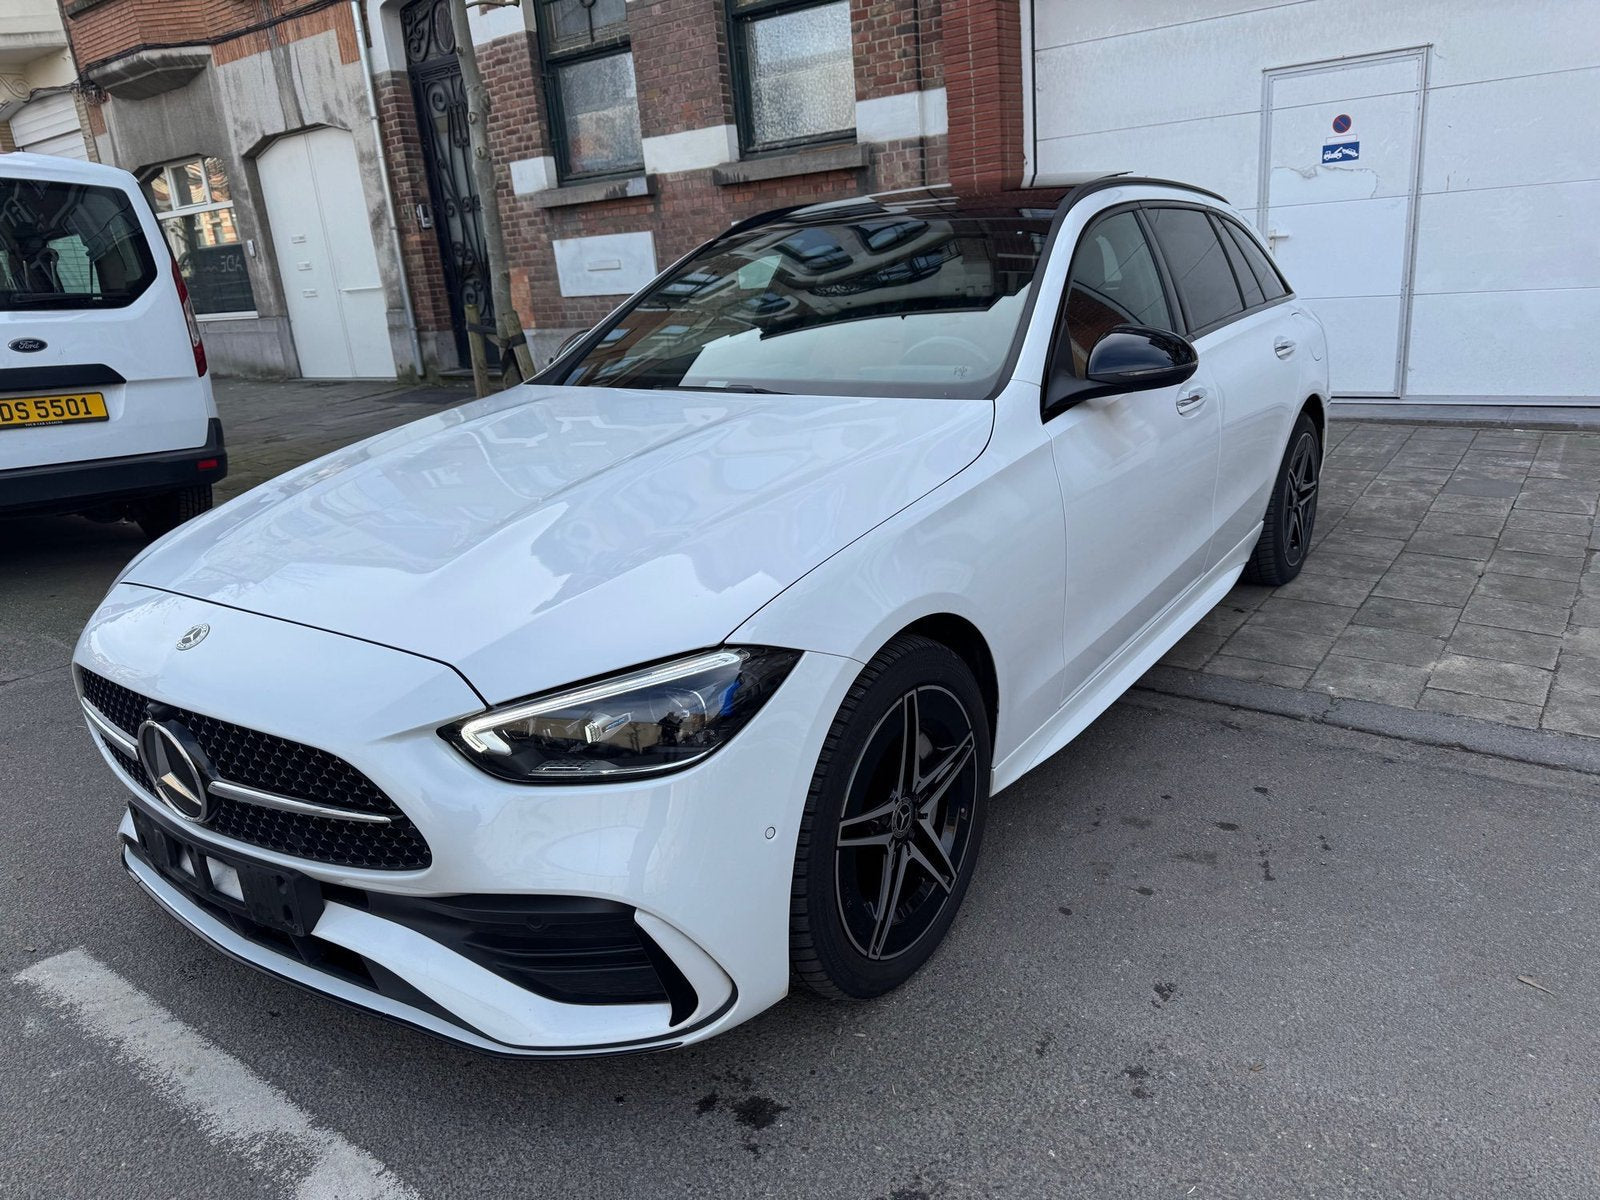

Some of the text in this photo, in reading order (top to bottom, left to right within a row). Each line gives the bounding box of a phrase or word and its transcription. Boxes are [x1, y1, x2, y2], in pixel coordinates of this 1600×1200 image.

[18, 340, 40, 349] Ford
[0, 397, 92, 421] DS 5501
